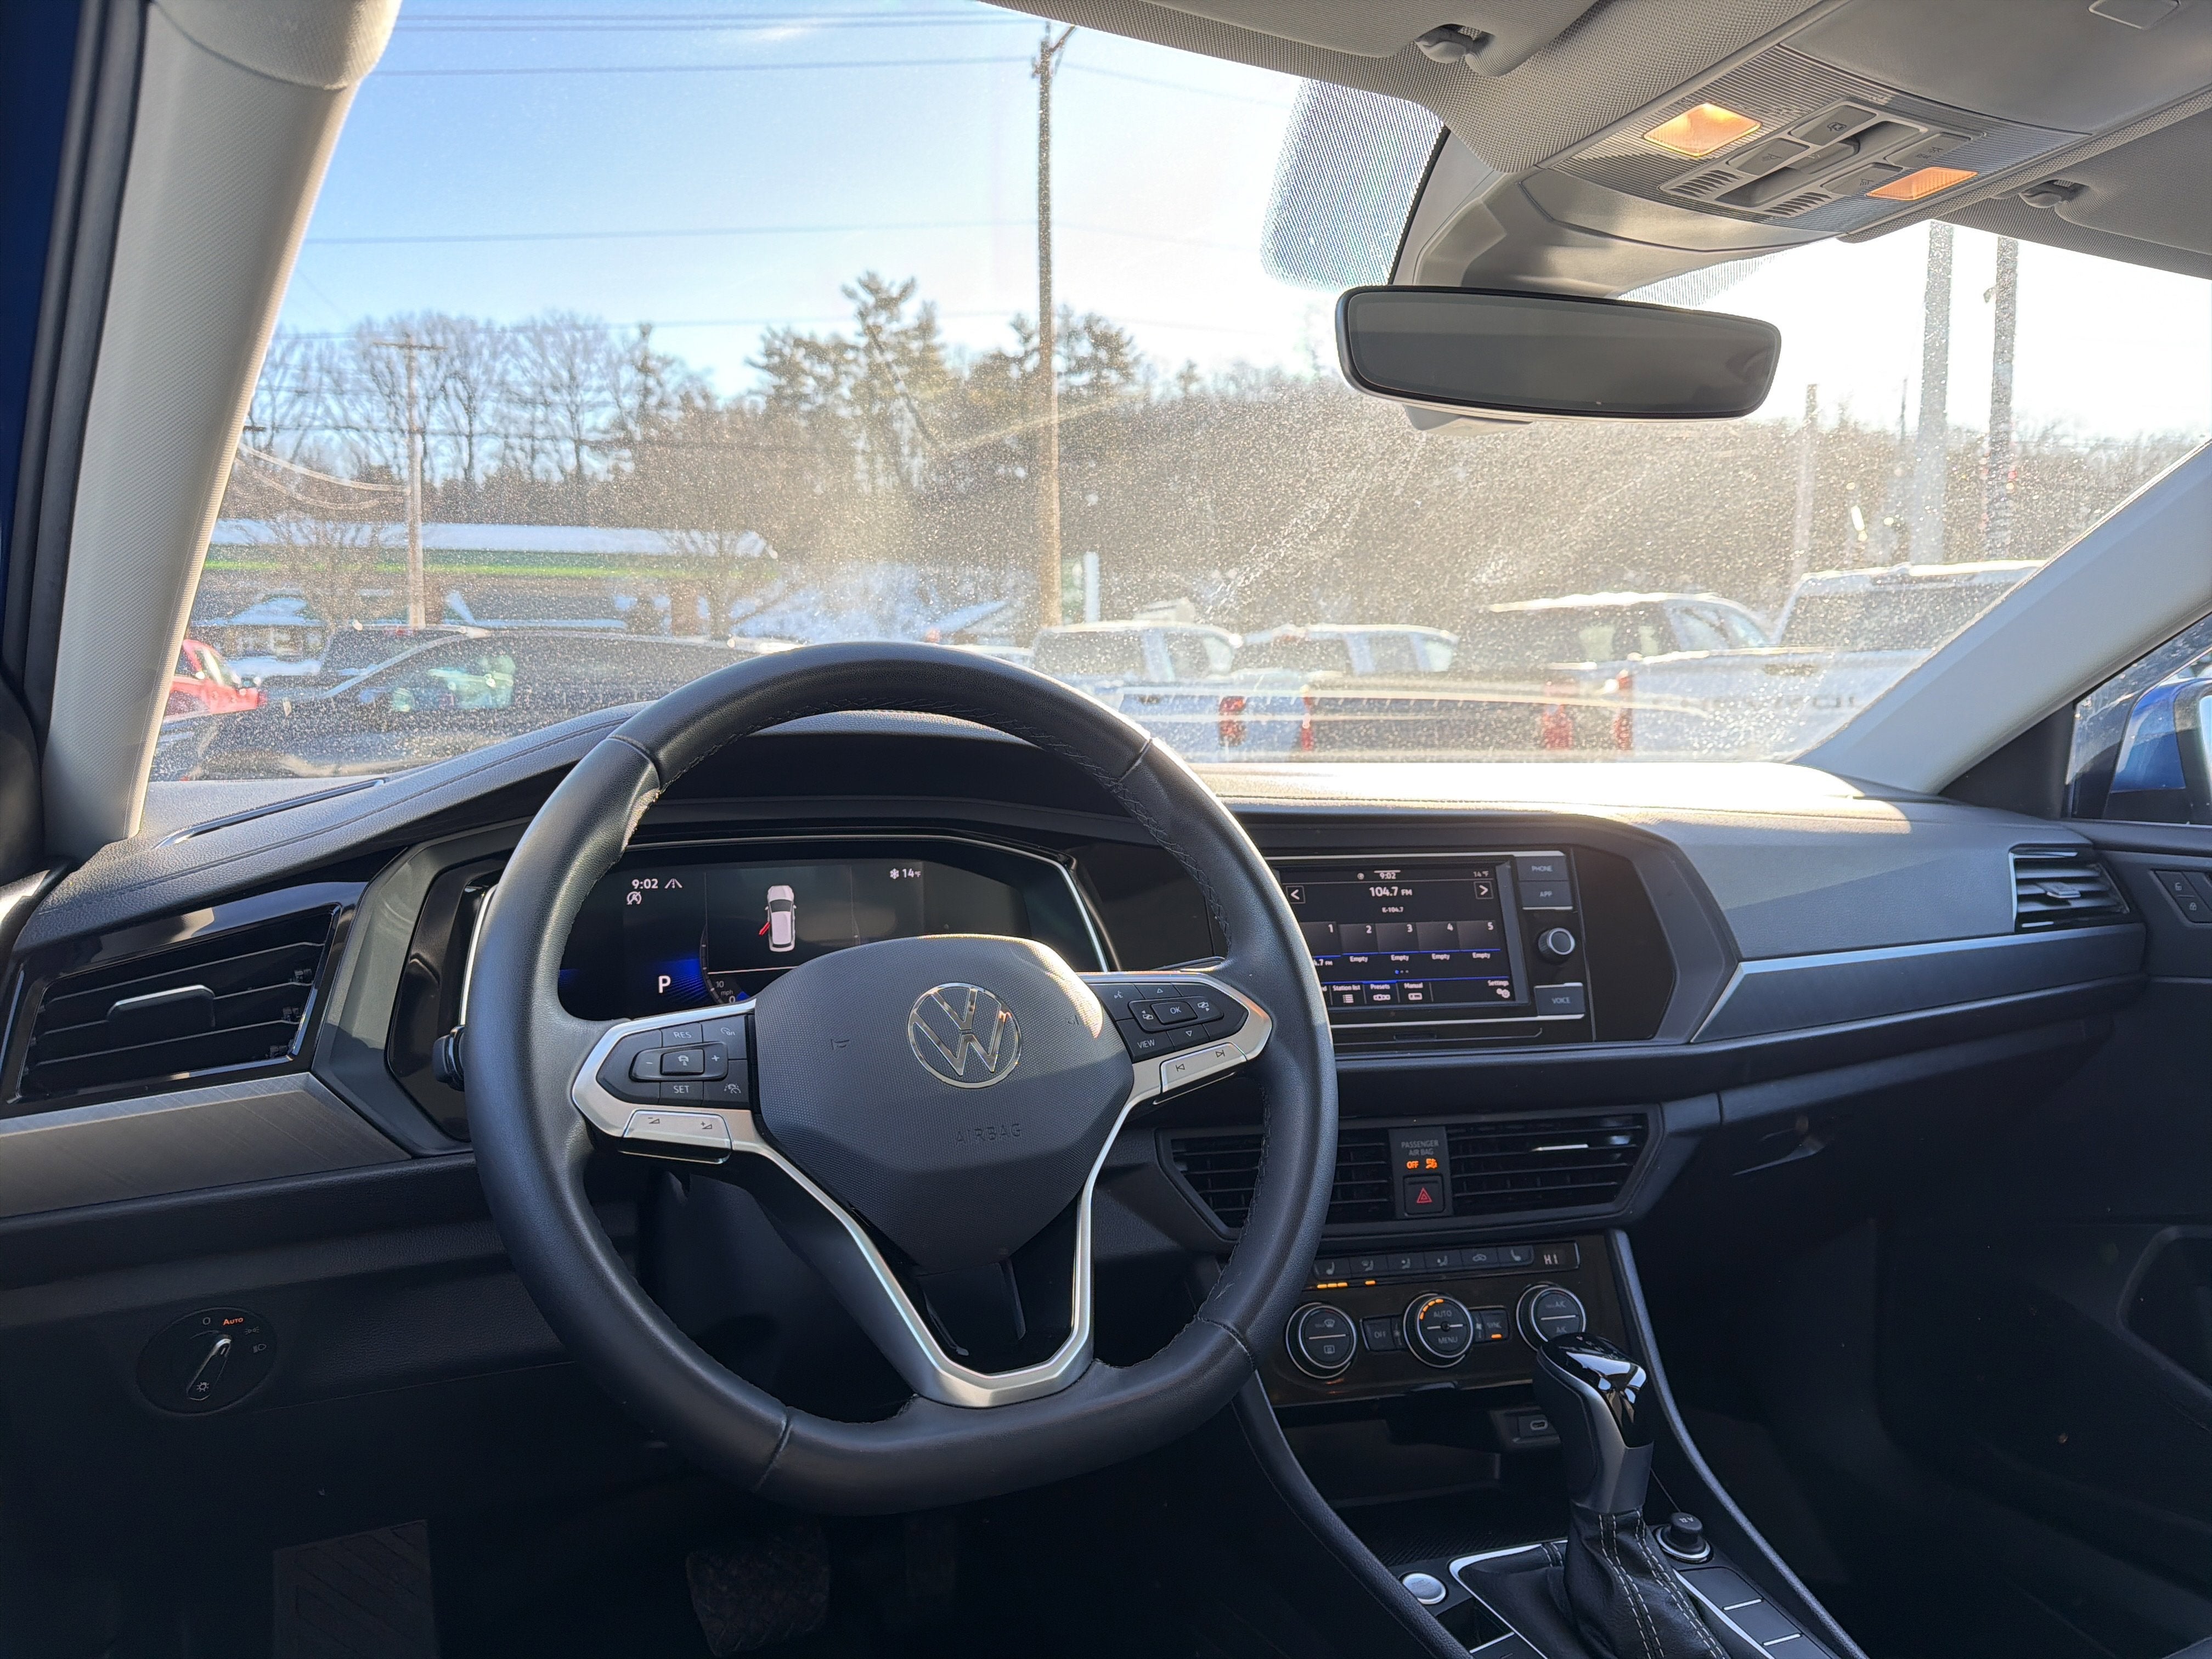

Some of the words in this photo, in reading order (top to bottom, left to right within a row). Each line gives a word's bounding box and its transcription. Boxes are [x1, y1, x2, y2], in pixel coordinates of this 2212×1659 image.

[632, 878, 658, 889] 9:02
[1369, 887, 1398, 896] 104.7
[1328, 924, 1334, 933] 1
[1365, 925, 1372, 933] 2
[1407, 924, 1413, 933] 3
[1487, 922, 1494, 930] 5
[658, 975, 672, 994] P
[1551, 996, 1571, 1005] VOICE
[1137, 1039, 1155, 1049] VIEW
[674, 1085, 690, 1093] SET
[955, 1123, 1023, 1146] AIRBAG
[1401, 1139, 1440, 1148] PASSENGER
[1406, 1160, 1419, 1169] OFF
[1543, 1254, 1558, 1265] HI
[1434, 1310, 1453, 1318] AUTO
